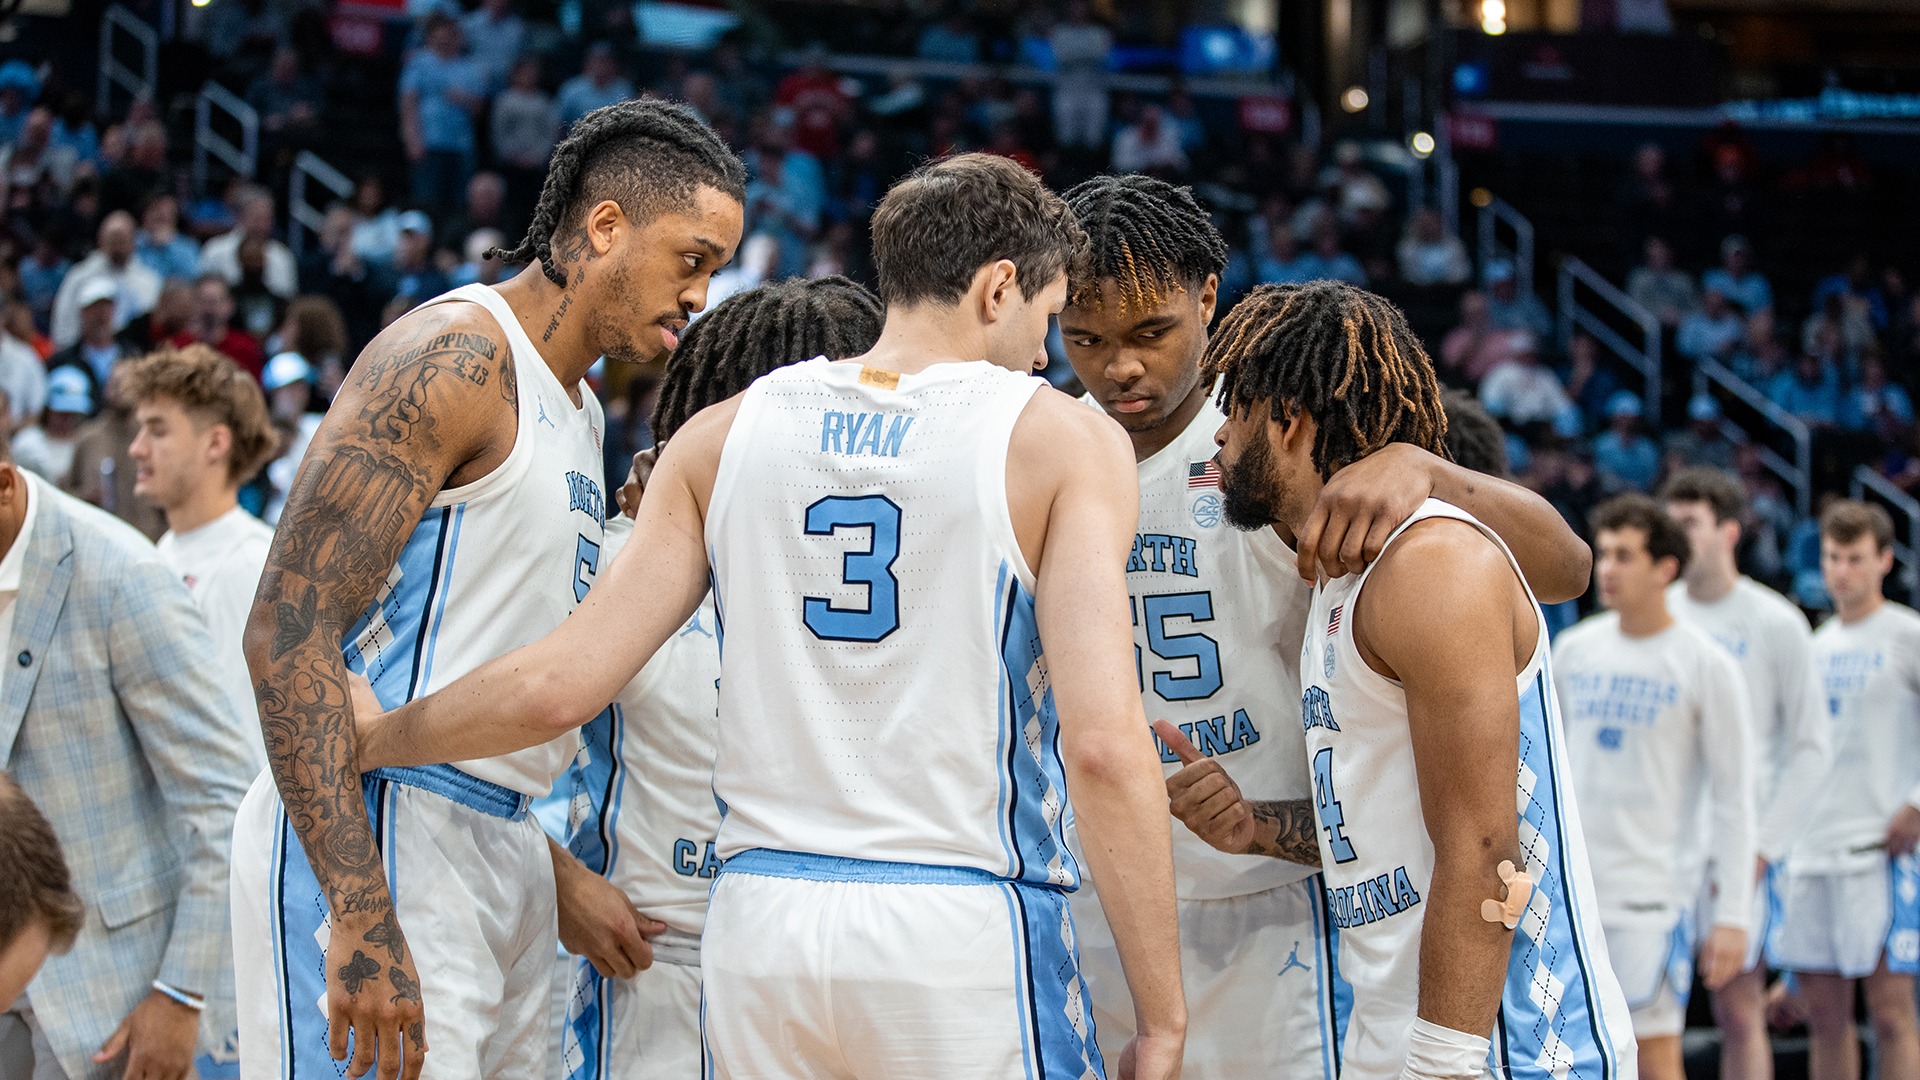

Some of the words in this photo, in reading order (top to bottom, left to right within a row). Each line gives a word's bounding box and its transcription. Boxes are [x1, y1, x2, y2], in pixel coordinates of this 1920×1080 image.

[821, 411, 914, 458] RYAN
[803, 494, 902, 643] 3
[1129, 591, 1224, 702] 5
[1302, 685, 1341, 734] ORTH
[1313, 746, 1358, 864] 4
